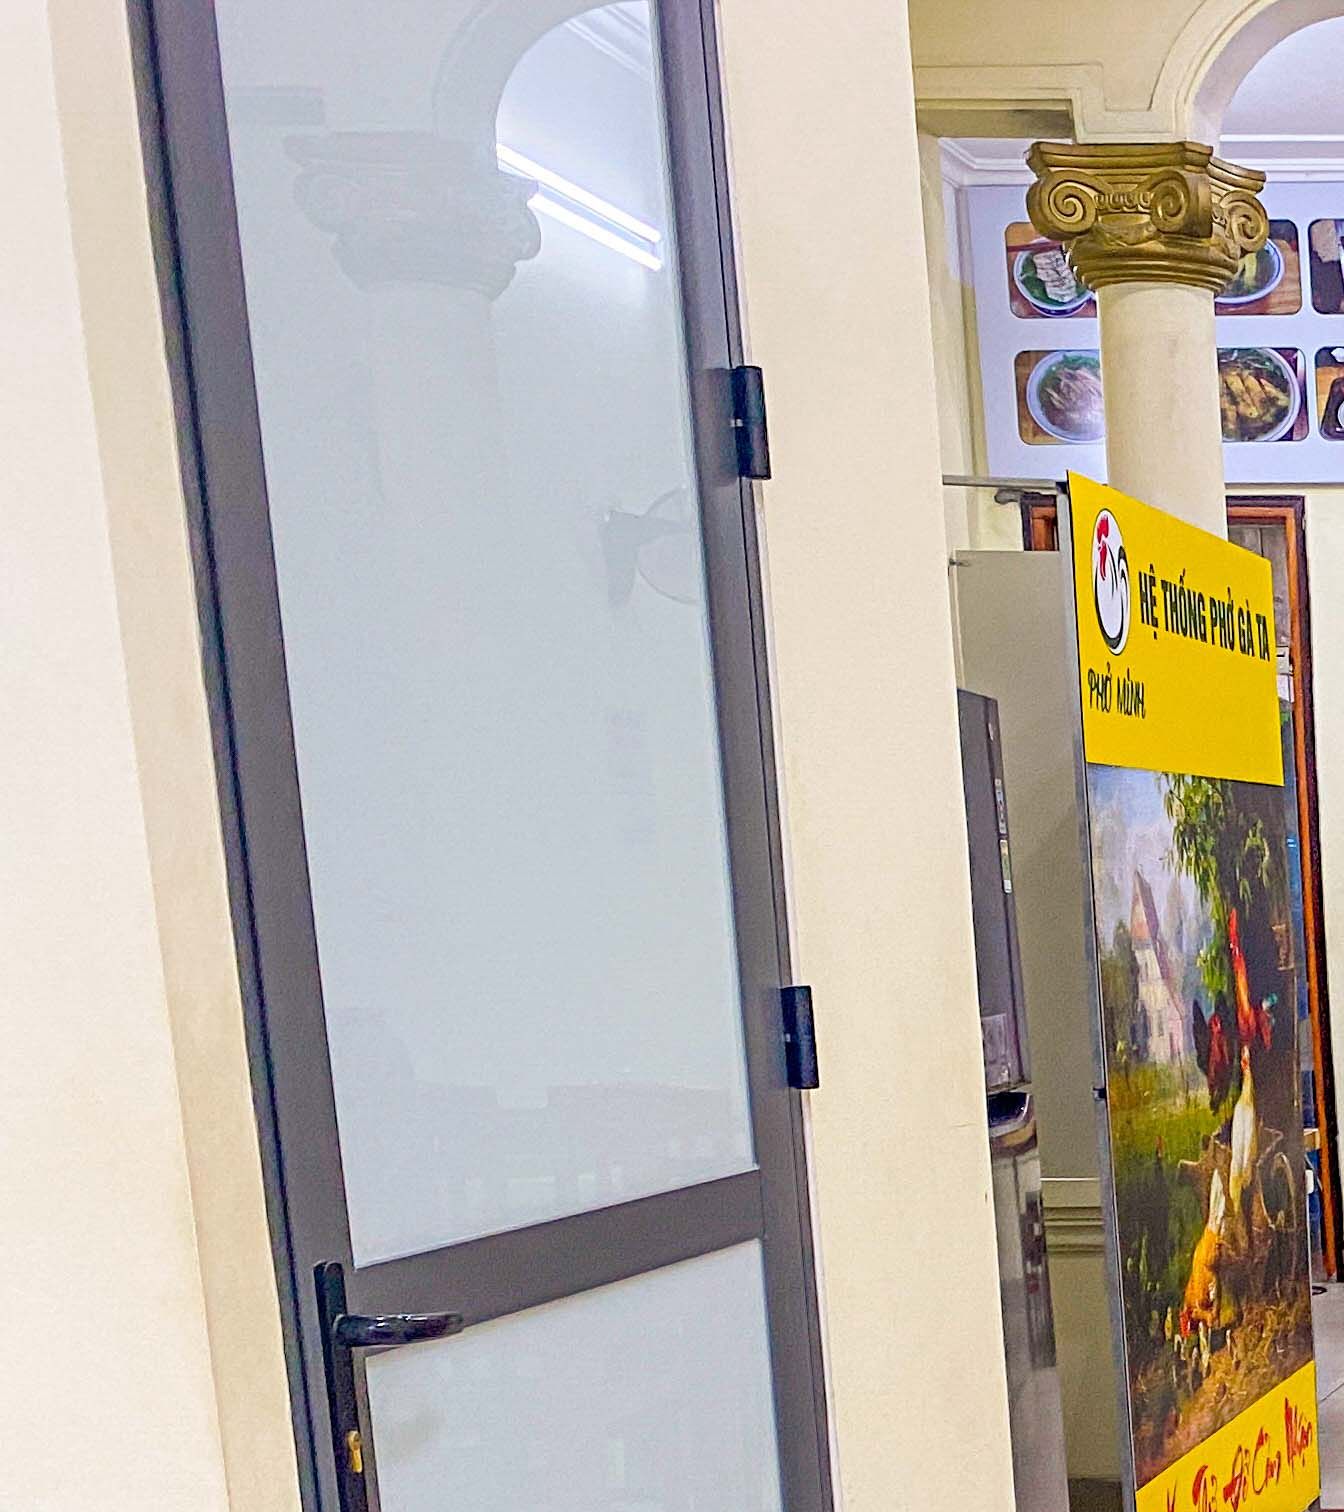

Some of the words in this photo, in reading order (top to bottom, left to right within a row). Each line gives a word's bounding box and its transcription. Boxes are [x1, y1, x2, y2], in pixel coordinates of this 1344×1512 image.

[1138, 563, 1158, 640] HỆ
[1160, 568, 1207, 643] THỐNG
[1209, 586, 1235, 652] PHỞ
[1237, 599, 1255, 657] GÀ
[1255, 613, 1270, 662] TA
[1088, 661, 1112, 713] PHỞ
